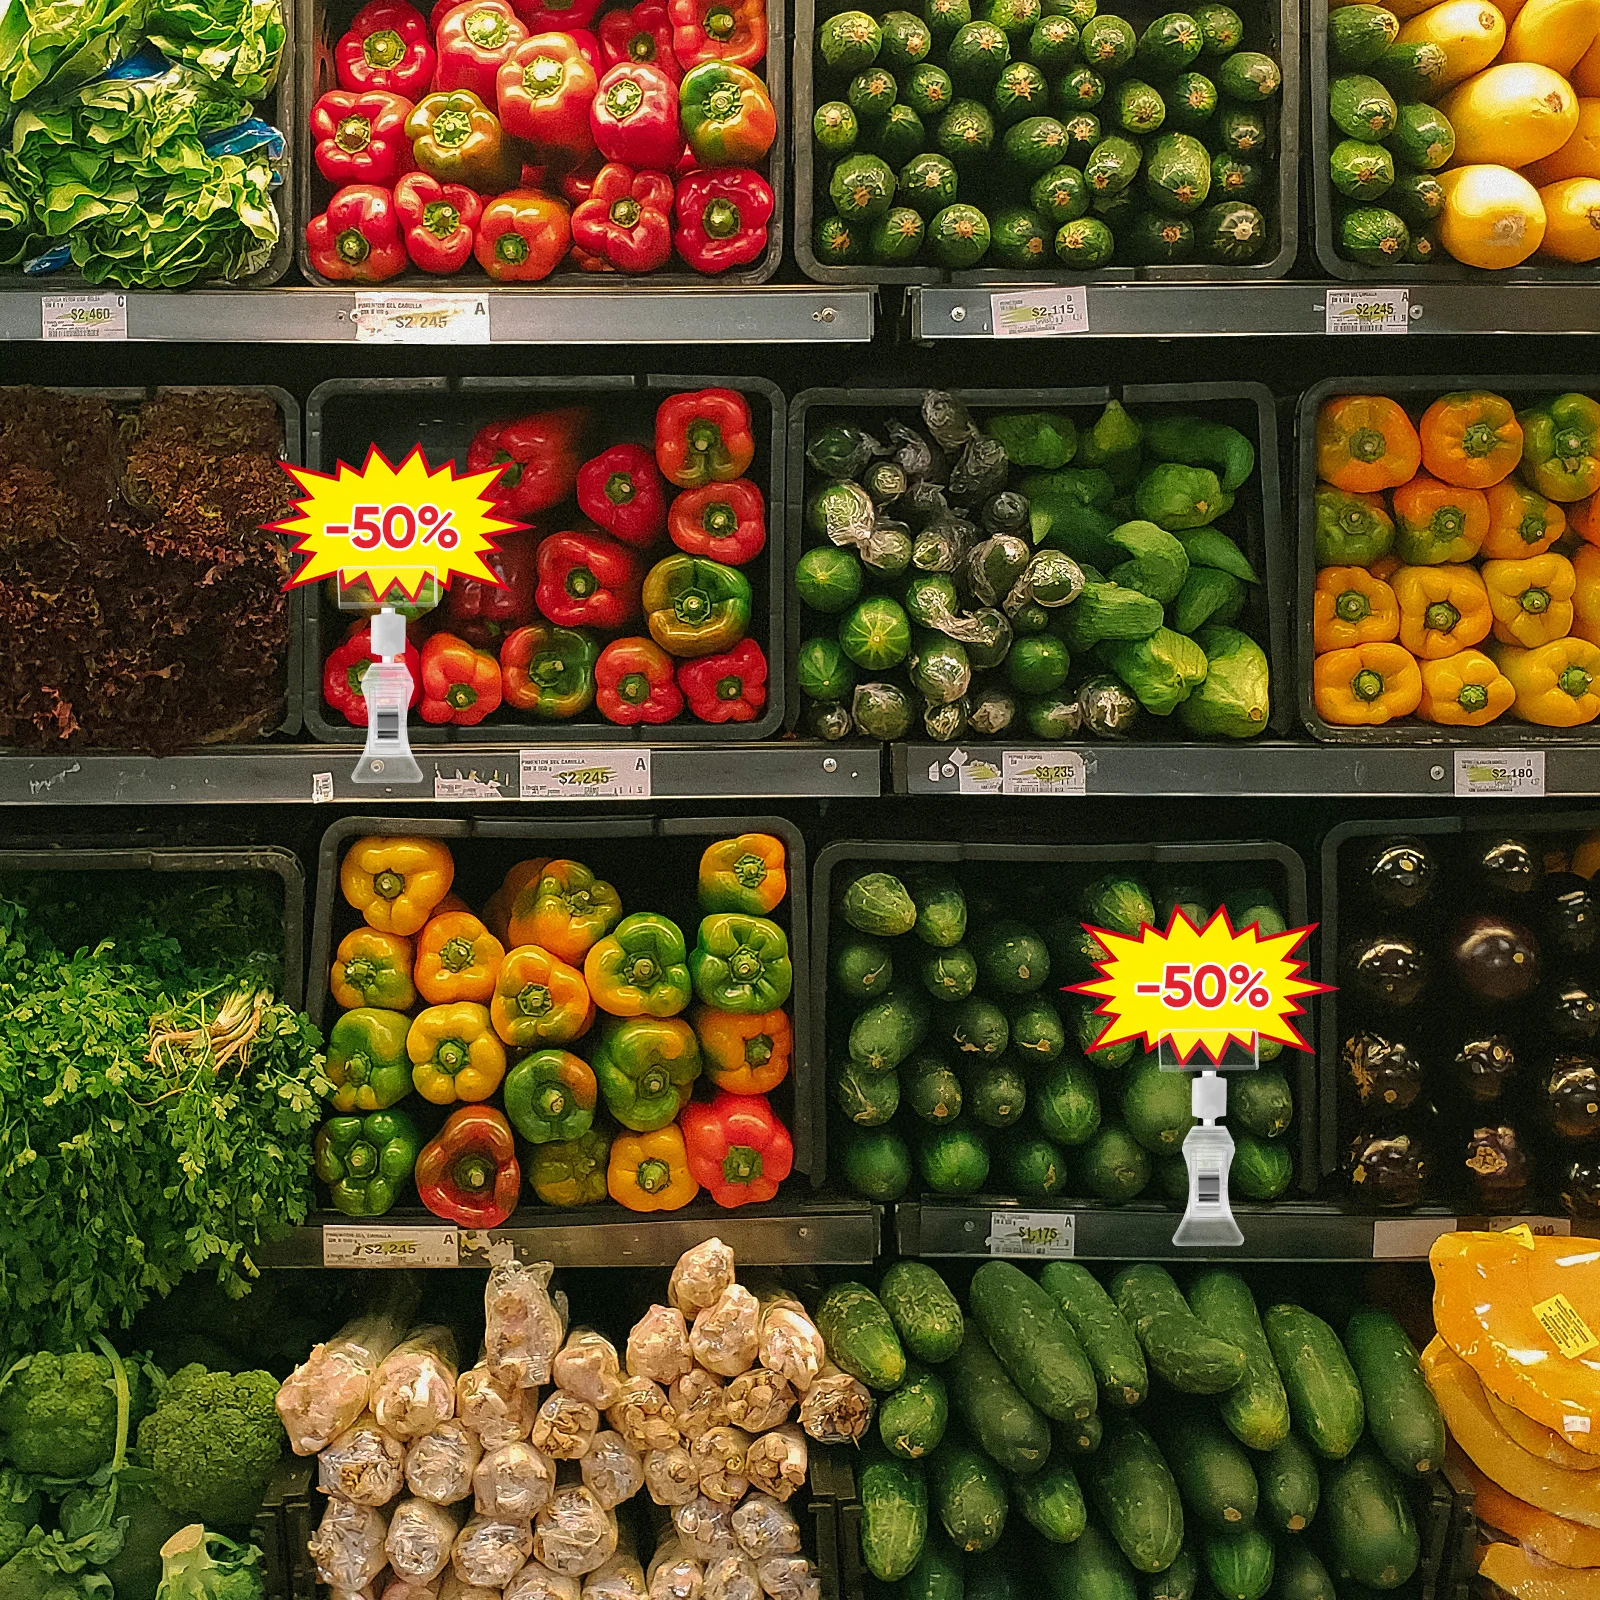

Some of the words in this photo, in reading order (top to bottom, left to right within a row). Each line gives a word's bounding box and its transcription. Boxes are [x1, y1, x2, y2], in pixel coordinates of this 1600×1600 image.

[118, 295, 124, 307] C
[1401, 292, 1409, 302] A
[71, 307, 110, 321] $2,460
[474, 302, 486, 315] A
[1355, 303, 1394, 316] $2,245
[395, 316, 447, 328] $2245
[635, 758, 646, 771] A
[558, 772, 609, 786] $2,245
[1035, 766, 1075, 780] $3,235
[1064, 1216, 1072, 1227] A
[443, 1235, 454, 1245] A
[364, 1244, 416, 1256] $2,245
